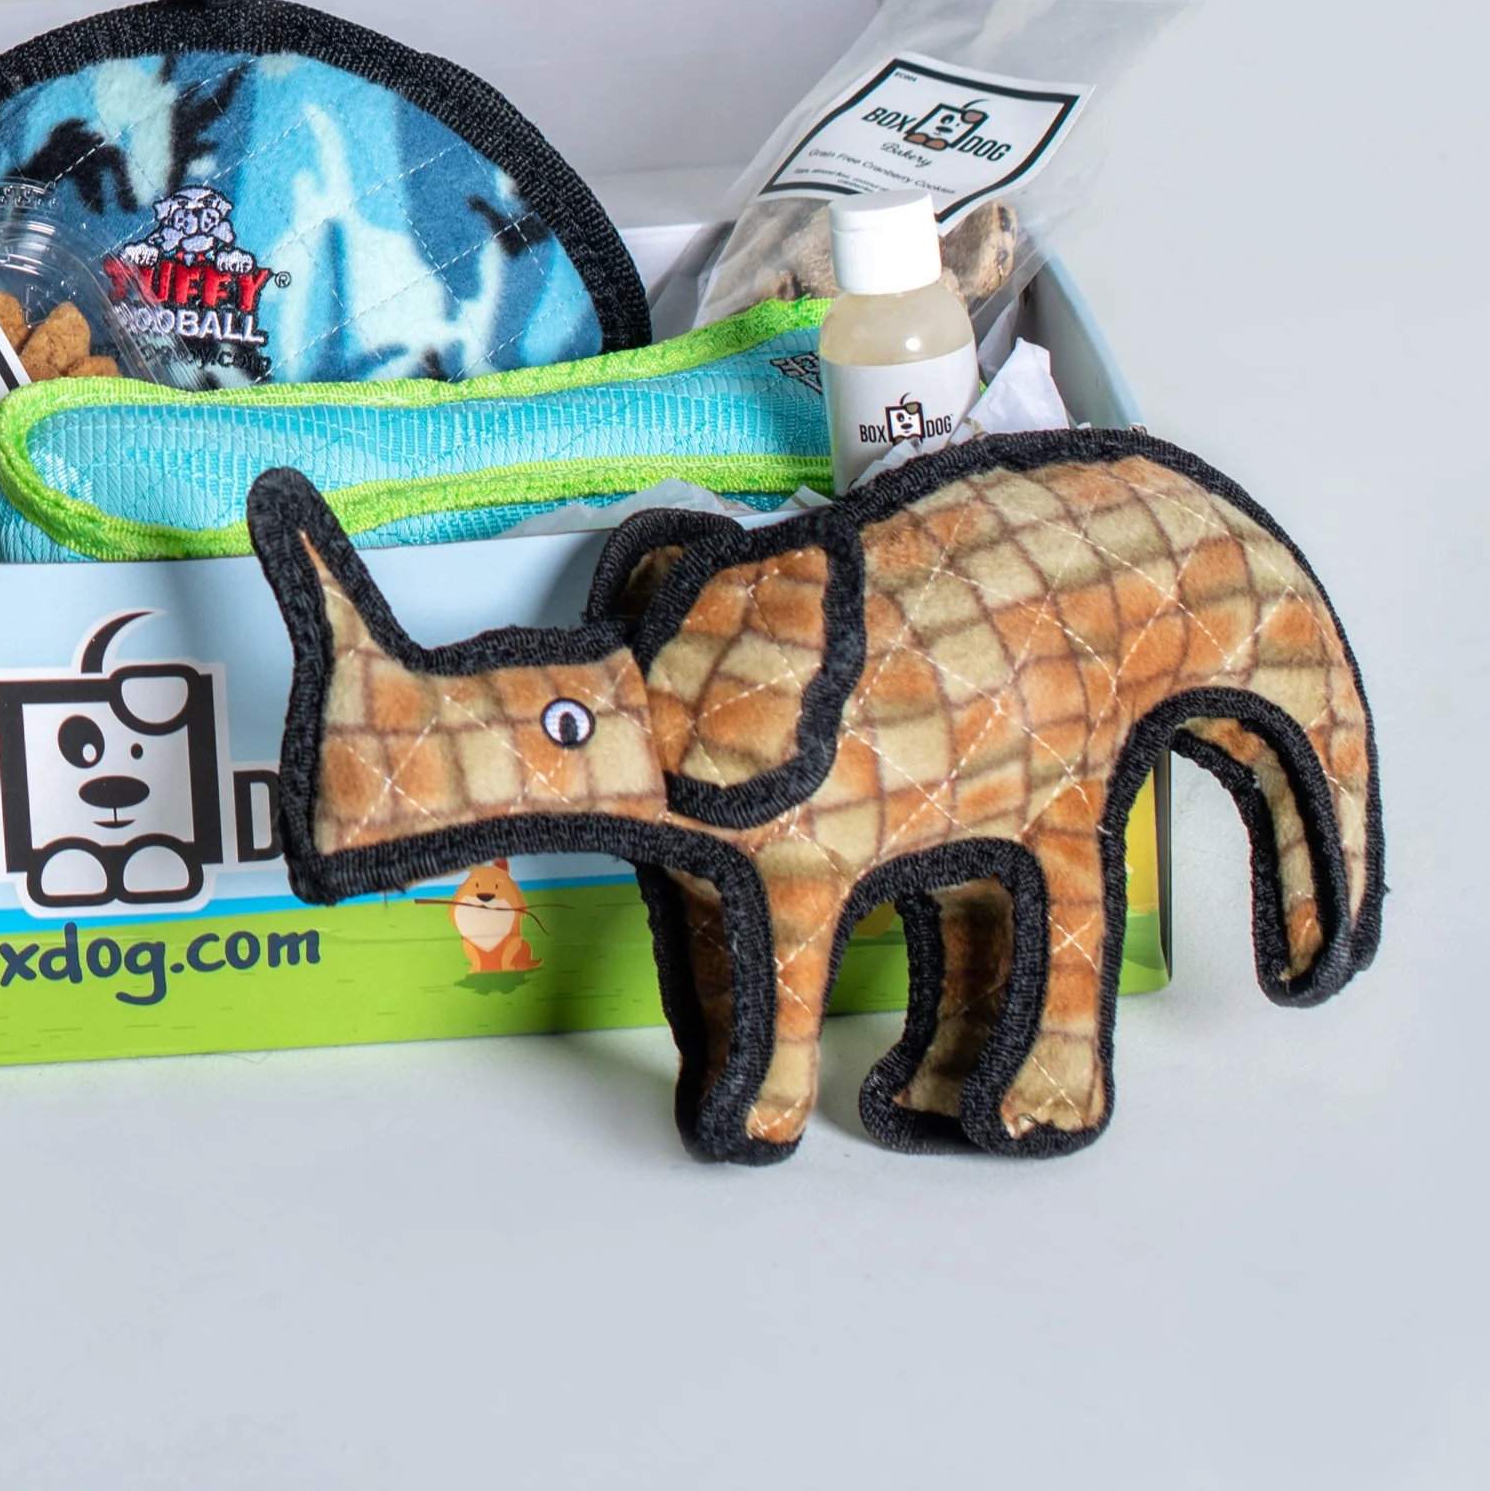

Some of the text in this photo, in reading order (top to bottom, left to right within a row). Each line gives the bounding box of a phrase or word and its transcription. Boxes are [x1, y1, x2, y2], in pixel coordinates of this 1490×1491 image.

[861, 107, 1012, 162] BOX DOG
[881, 142, 932, 168] Bakery
[809, 148, 956, 194] Grain Free Cranberry Cookies
[103, 258, 270, 311] TUFFY
[859, 416, 952, 443] BOX DOG
